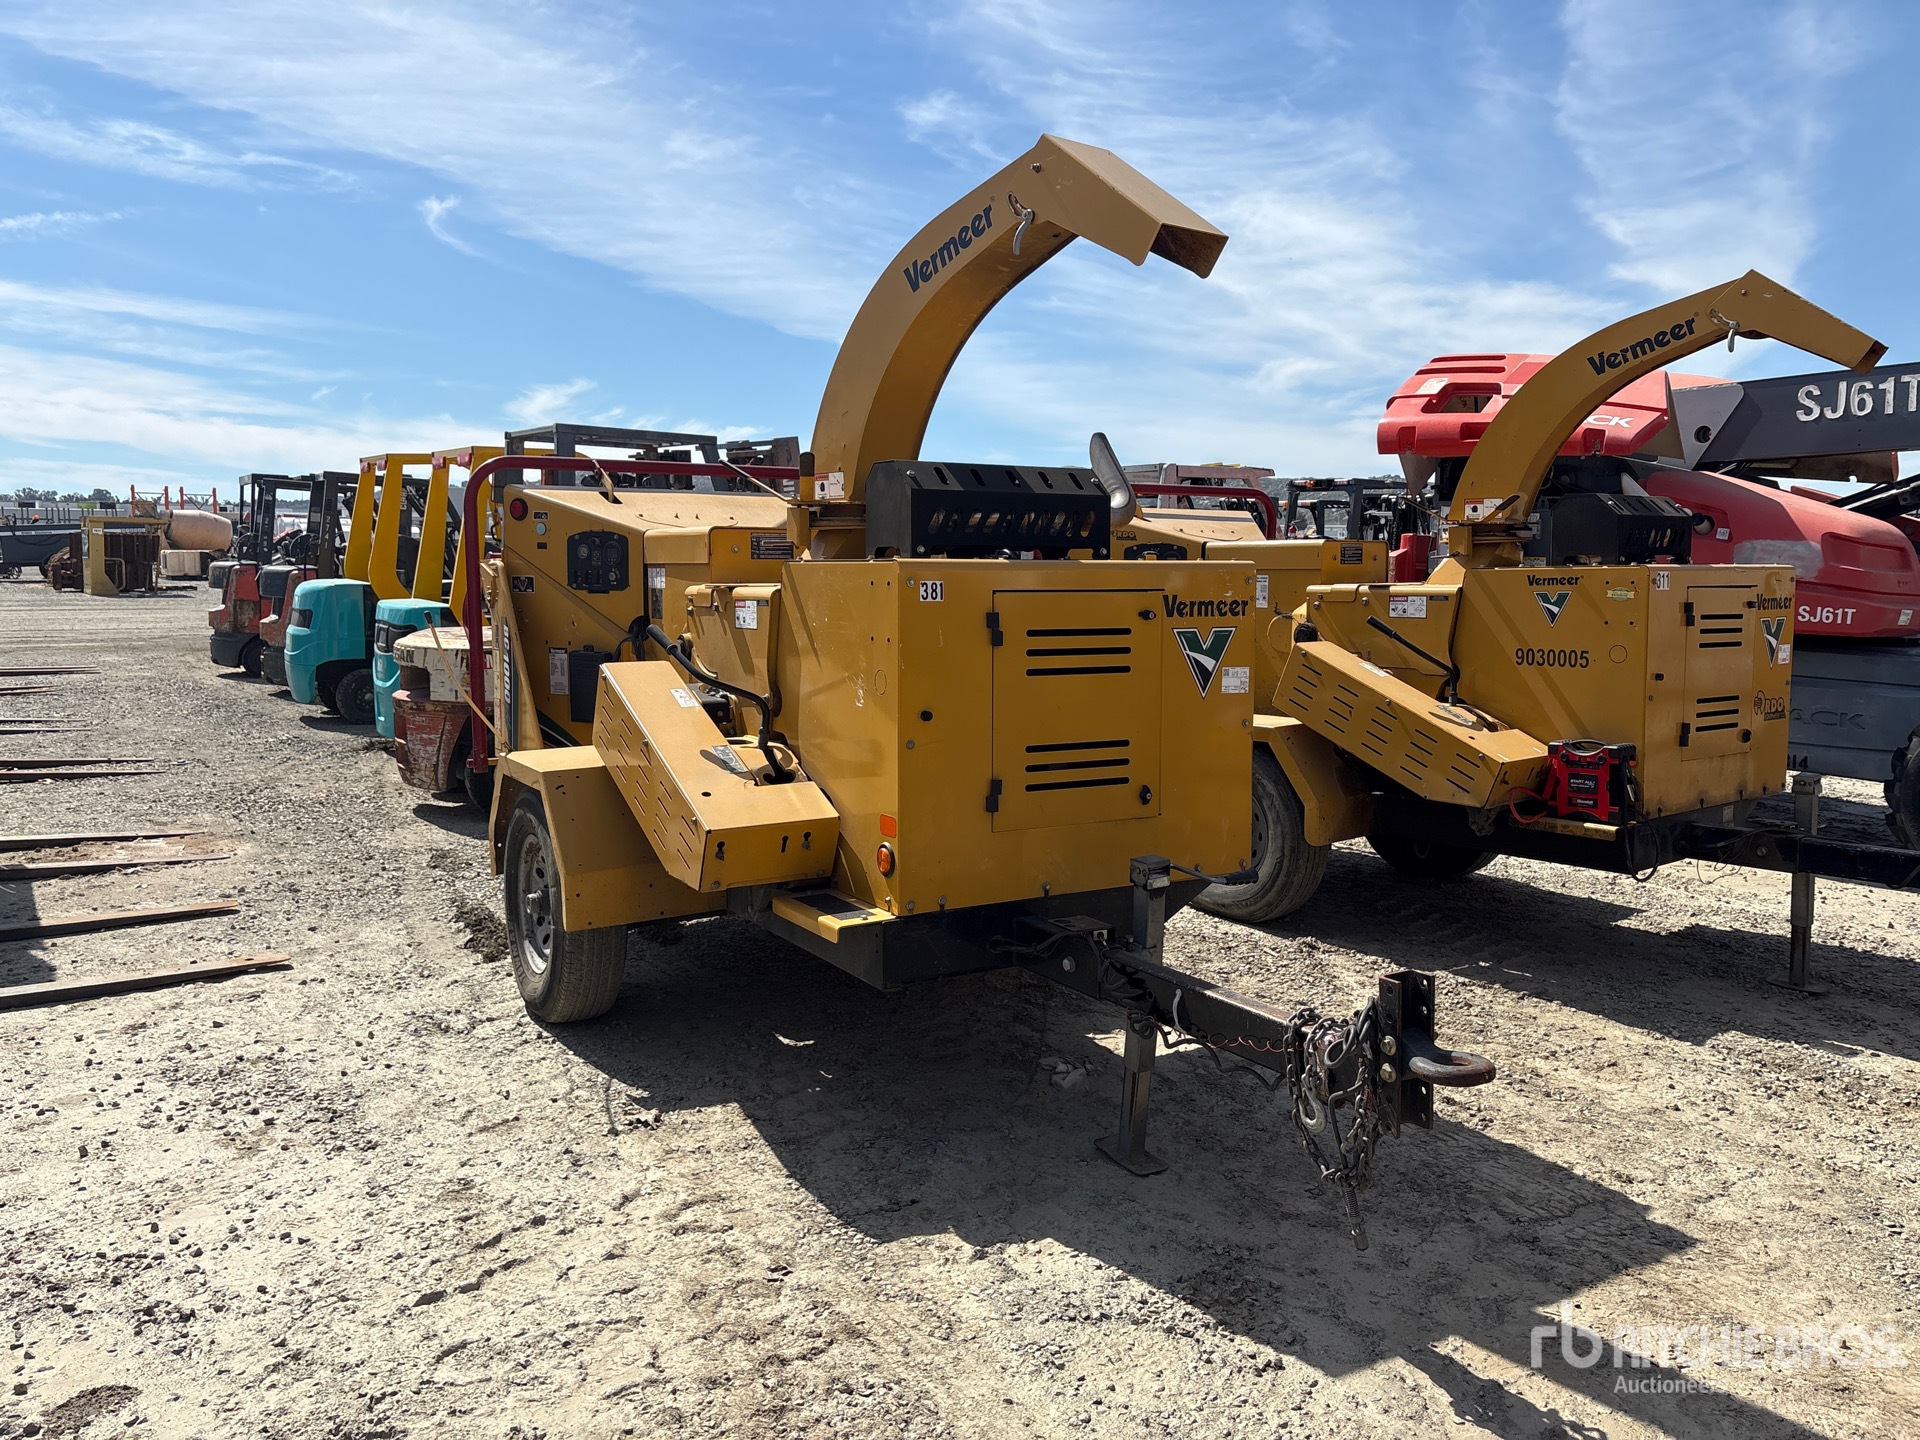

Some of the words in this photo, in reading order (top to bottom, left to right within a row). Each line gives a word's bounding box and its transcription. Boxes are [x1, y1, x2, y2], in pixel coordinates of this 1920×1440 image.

[903, 204, 993, 293] Vermeer
[1587, 317, 1696, 376] Vermeer
[1796, 374, 1920, 422] SJ61T
[1584, 415, 1635, 428] CK
[920, 582, 944, 600] 381
[1527, 575, 1581, 587] Vermeer
[1656, 573, 1670, 589] 311
[1162, 594, 1249, 618] Vermeer
[1756, 593, 1793, 611] Vermeer
[1797, 605, 1857, 625] SJ61T
[1515, 648, 1590, 669] 9030005
